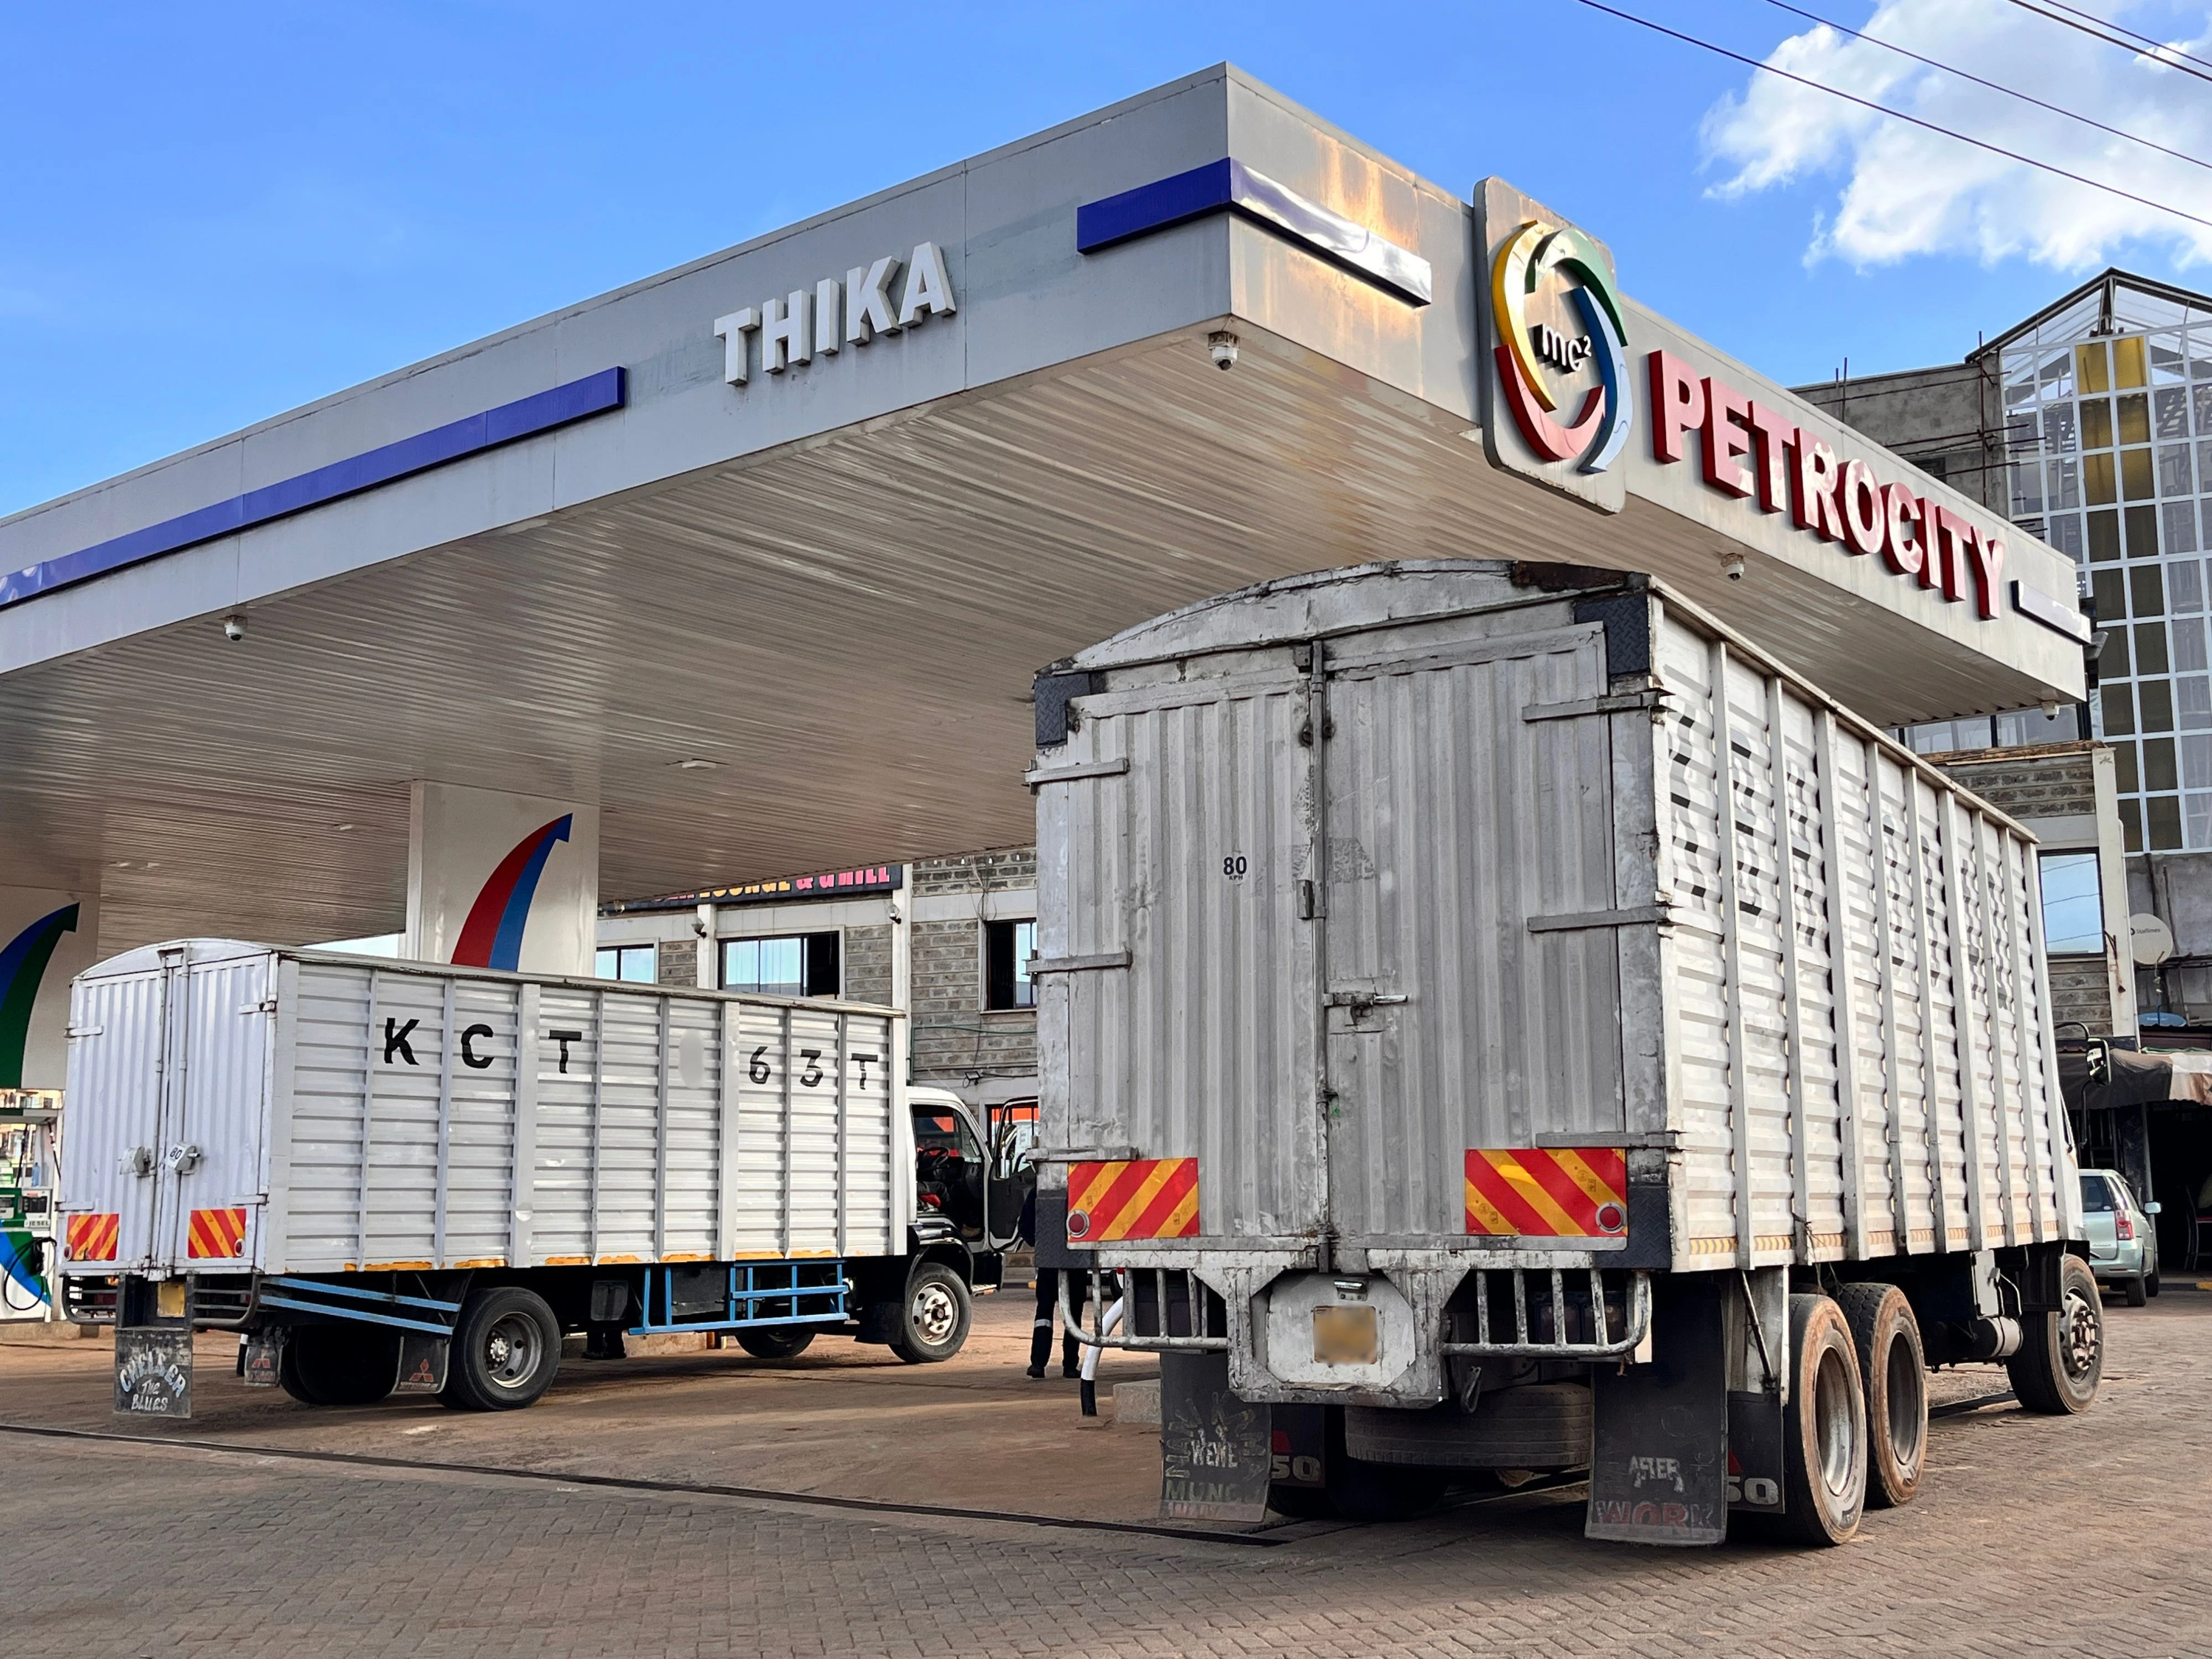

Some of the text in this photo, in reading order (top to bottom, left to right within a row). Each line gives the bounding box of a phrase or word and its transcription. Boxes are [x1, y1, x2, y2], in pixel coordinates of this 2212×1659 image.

[714, 241, 956, 386] THIKA
[1648, 349, 2005, 620] PETROCITY
[1223, 856, 1247, 875] 80
[170, 1147, 182, 1160] 80
